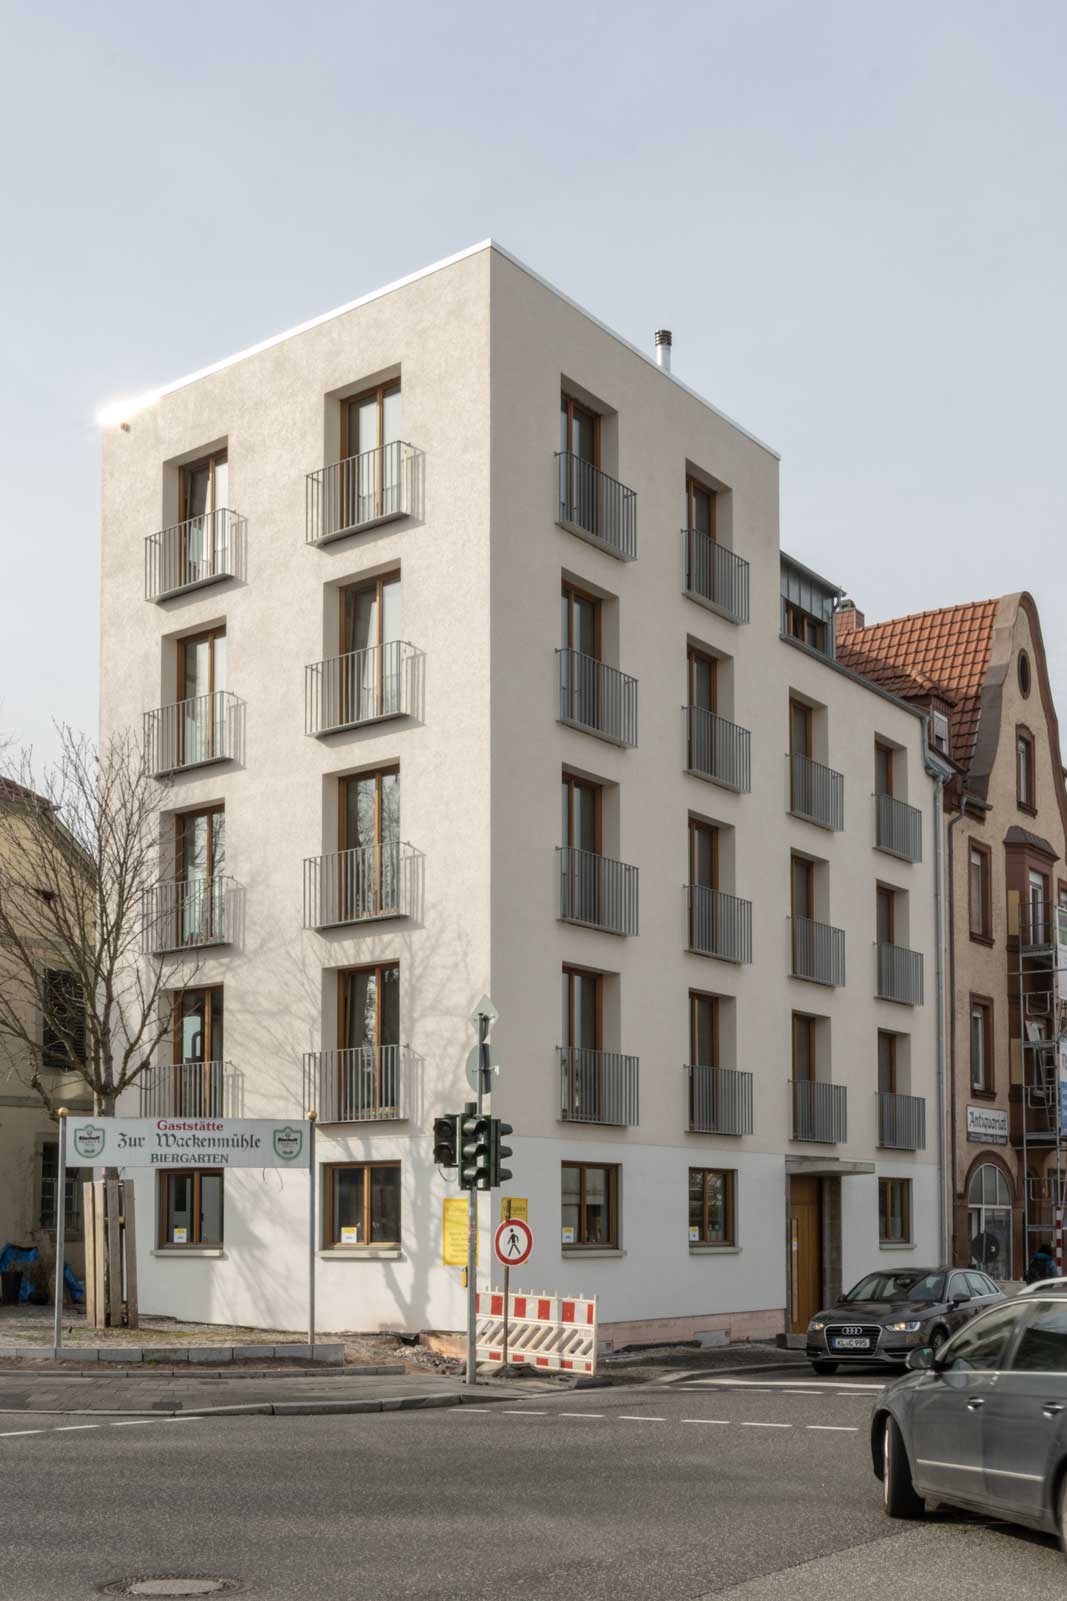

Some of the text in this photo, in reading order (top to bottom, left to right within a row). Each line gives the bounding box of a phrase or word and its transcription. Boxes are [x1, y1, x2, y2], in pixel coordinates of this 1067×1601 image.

[157, 1120, 224, 1132] Gaststätte
[117, 1132, 261, 1150] Zur Wackenmühle
[151, 1153, 229, 1164] BIERGARTEN
